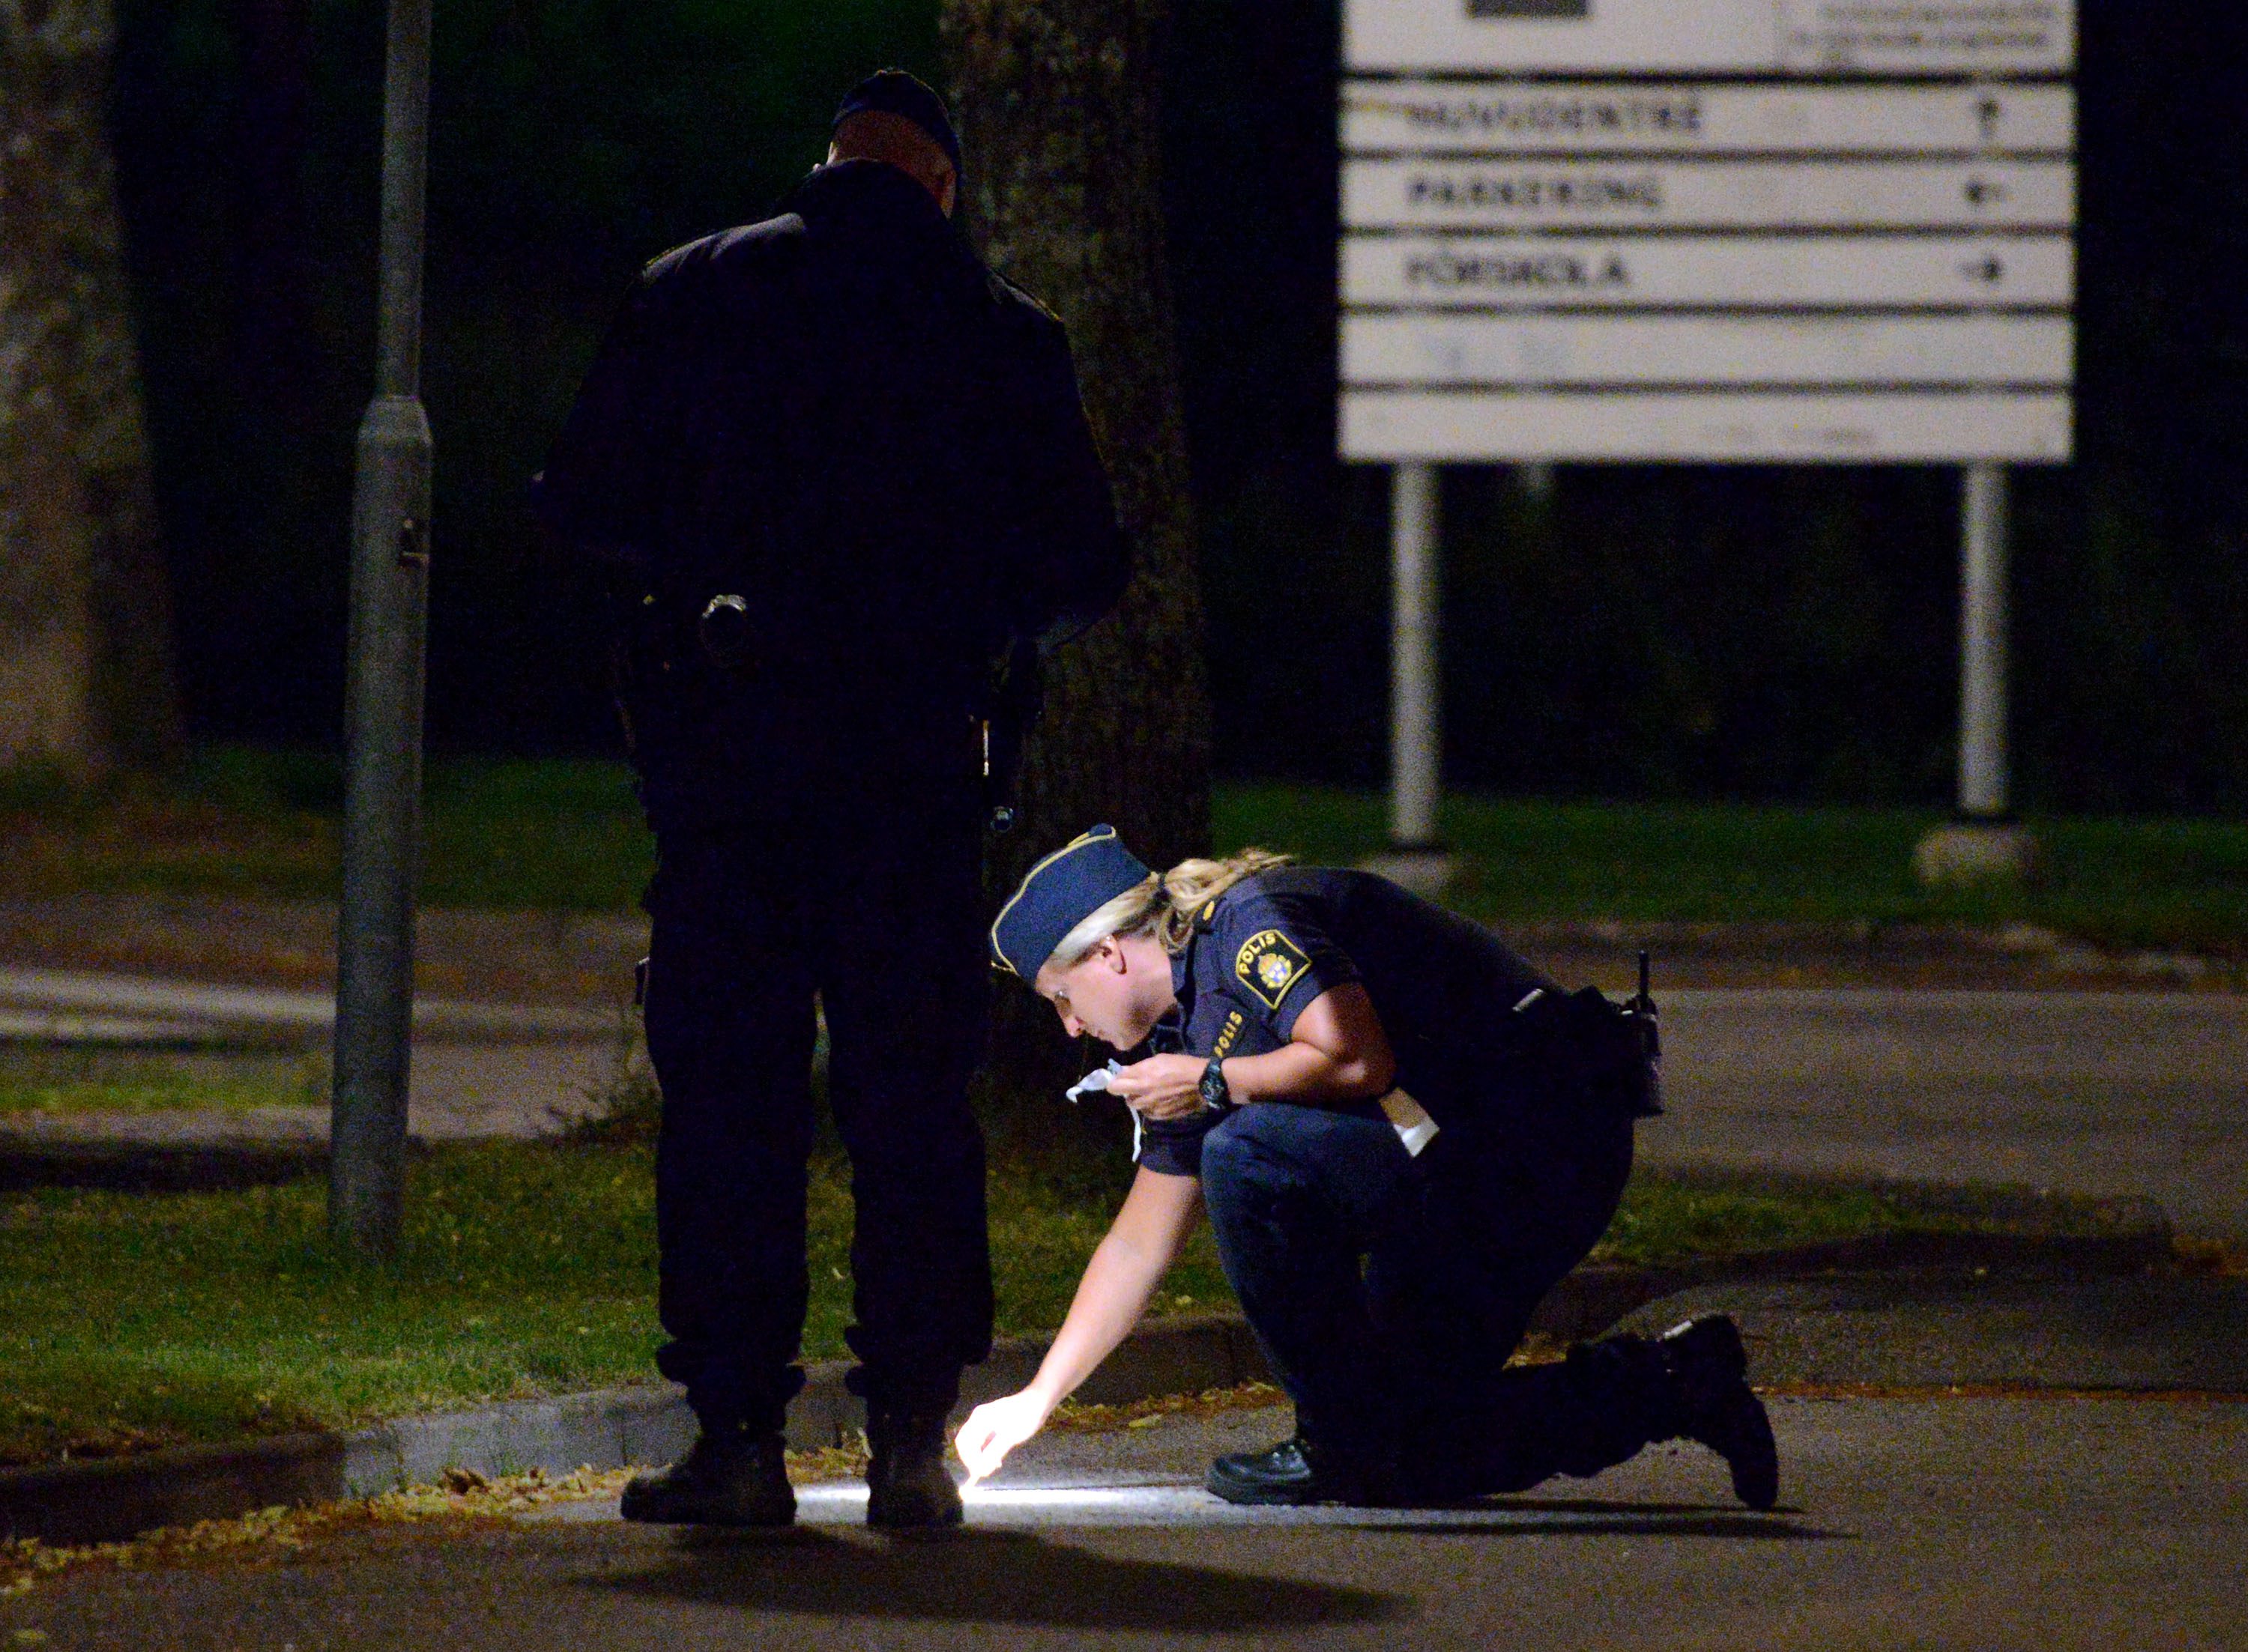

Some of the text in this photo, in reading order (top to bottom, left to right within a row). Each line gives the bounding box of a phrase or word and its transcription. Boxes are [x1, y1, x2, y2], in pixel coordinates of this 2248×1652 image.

[1407, 176, 1661, 208] PARKERING
[1406, 246, 1631, 285] FÖRSKOLA
[1239, 933, 1276, 974] POLIS
[1214, 1011, 1242, 1058] POLIS
